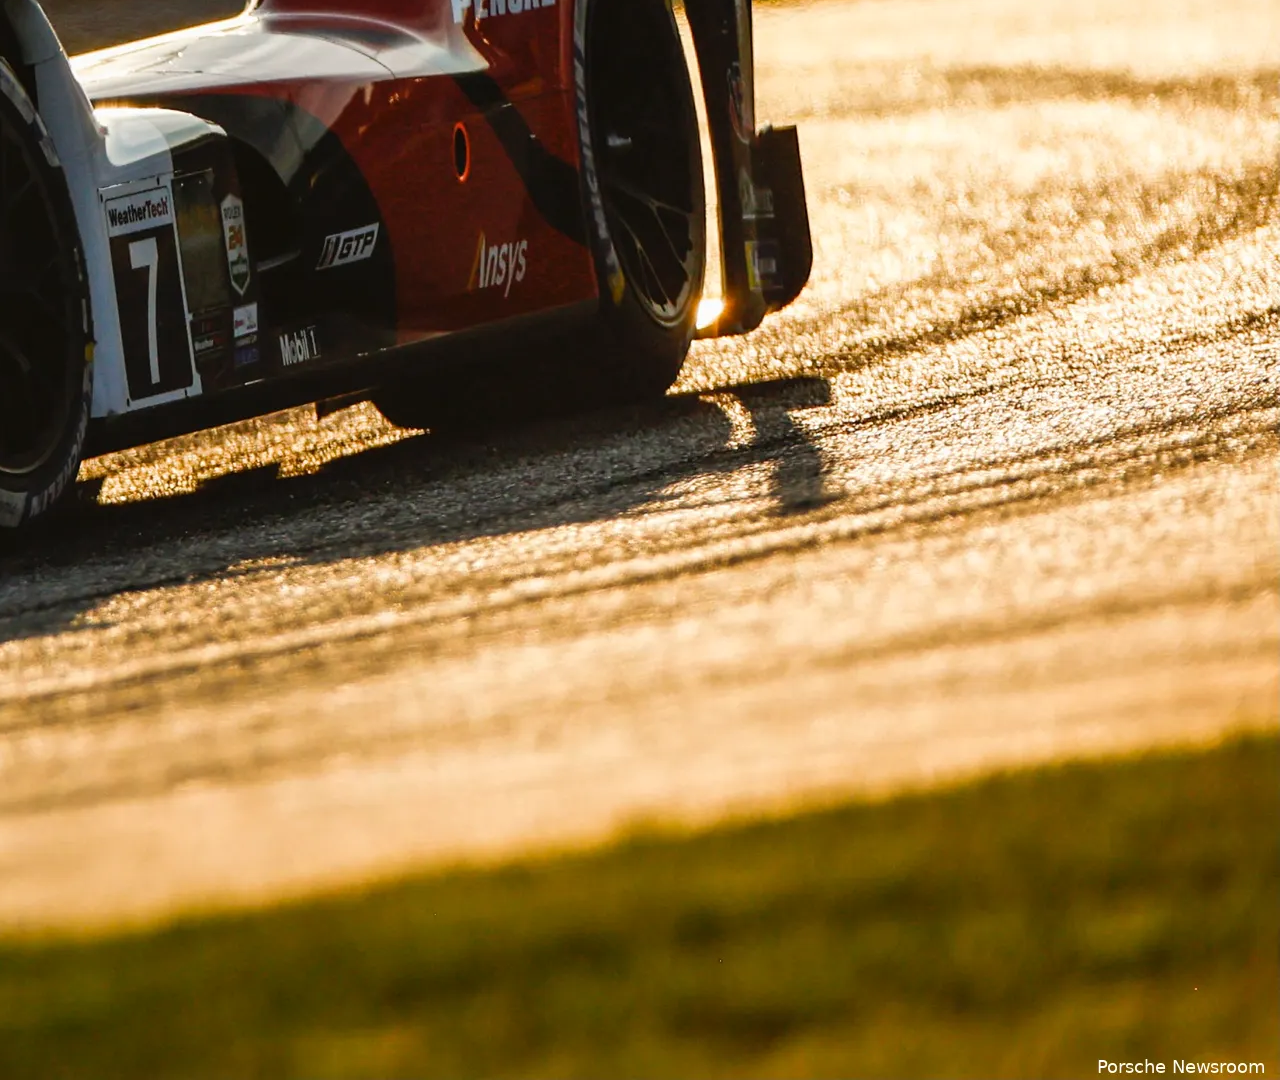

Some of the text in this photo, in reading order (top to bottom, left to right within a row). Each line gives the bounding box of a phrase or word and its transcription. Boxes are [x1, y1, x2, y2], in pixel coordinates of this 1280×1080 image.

[108, 196, 169, 228] WeatherTech
[338, 230, 375, 260] GTP
[467, 229, 529, 298] Ansys
[128, 237, 161, 385] 7
[279, 329, 309, 366] Mobil
